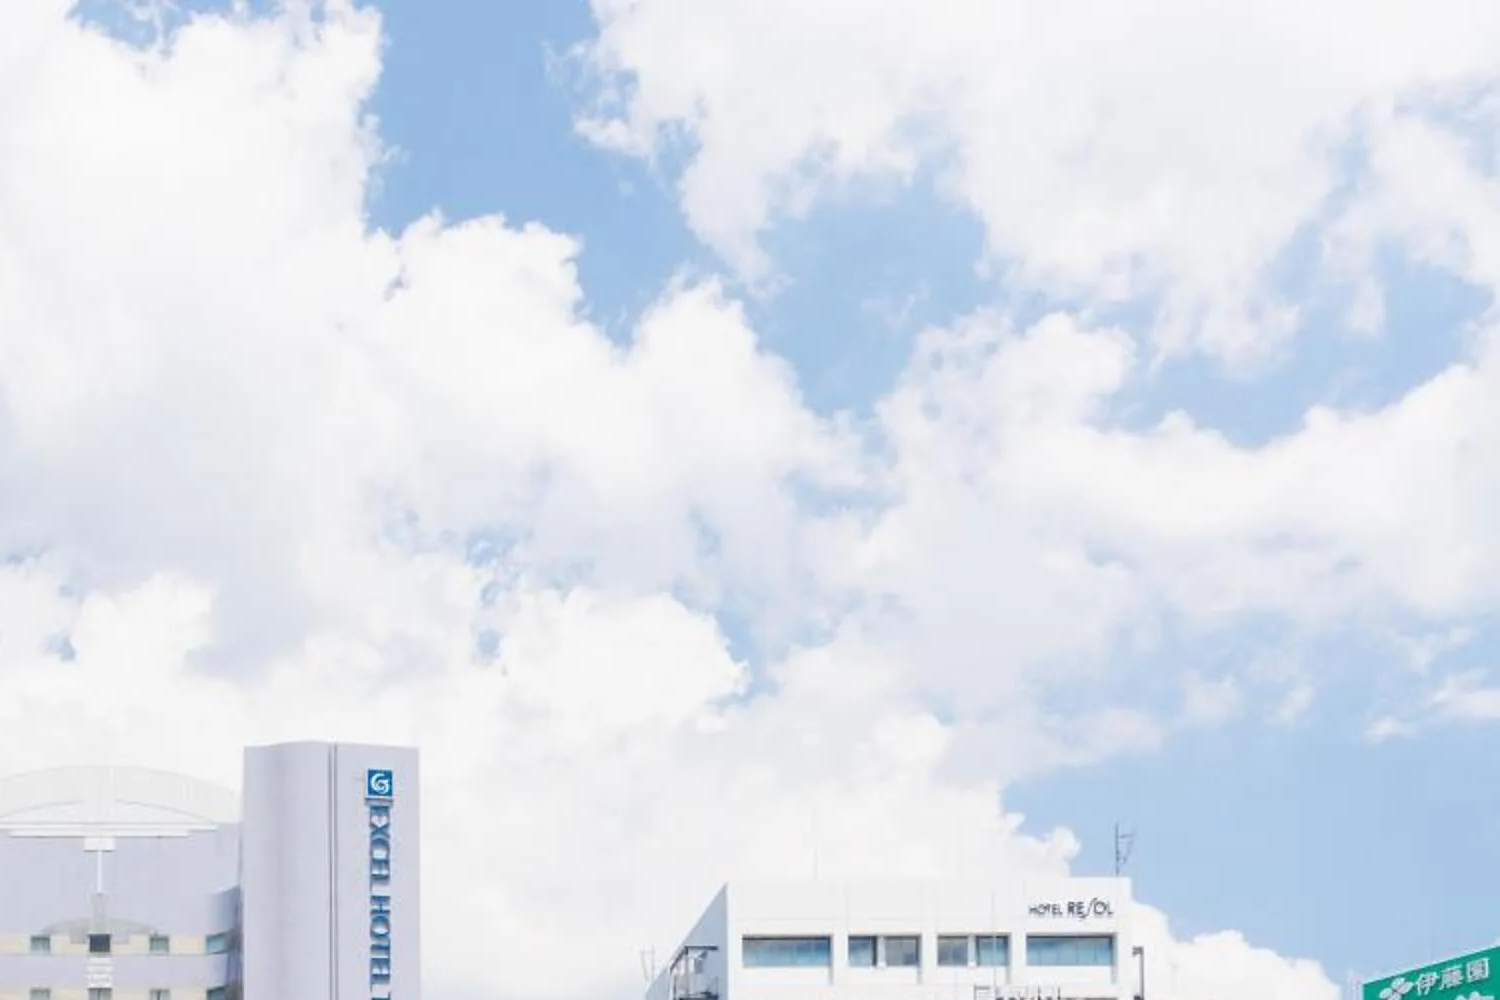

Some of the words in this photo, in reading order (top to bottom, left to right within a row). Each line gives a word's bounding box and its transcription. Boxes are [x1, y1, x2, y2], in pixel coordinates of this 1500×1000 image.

[369, 805, 391, 893] EXCEL
[1028, 903, 1063, 917] HOTEL
[369, 895, 392, 992] HOTEL
[1414, 957, 1490, 997] 伊藤園
